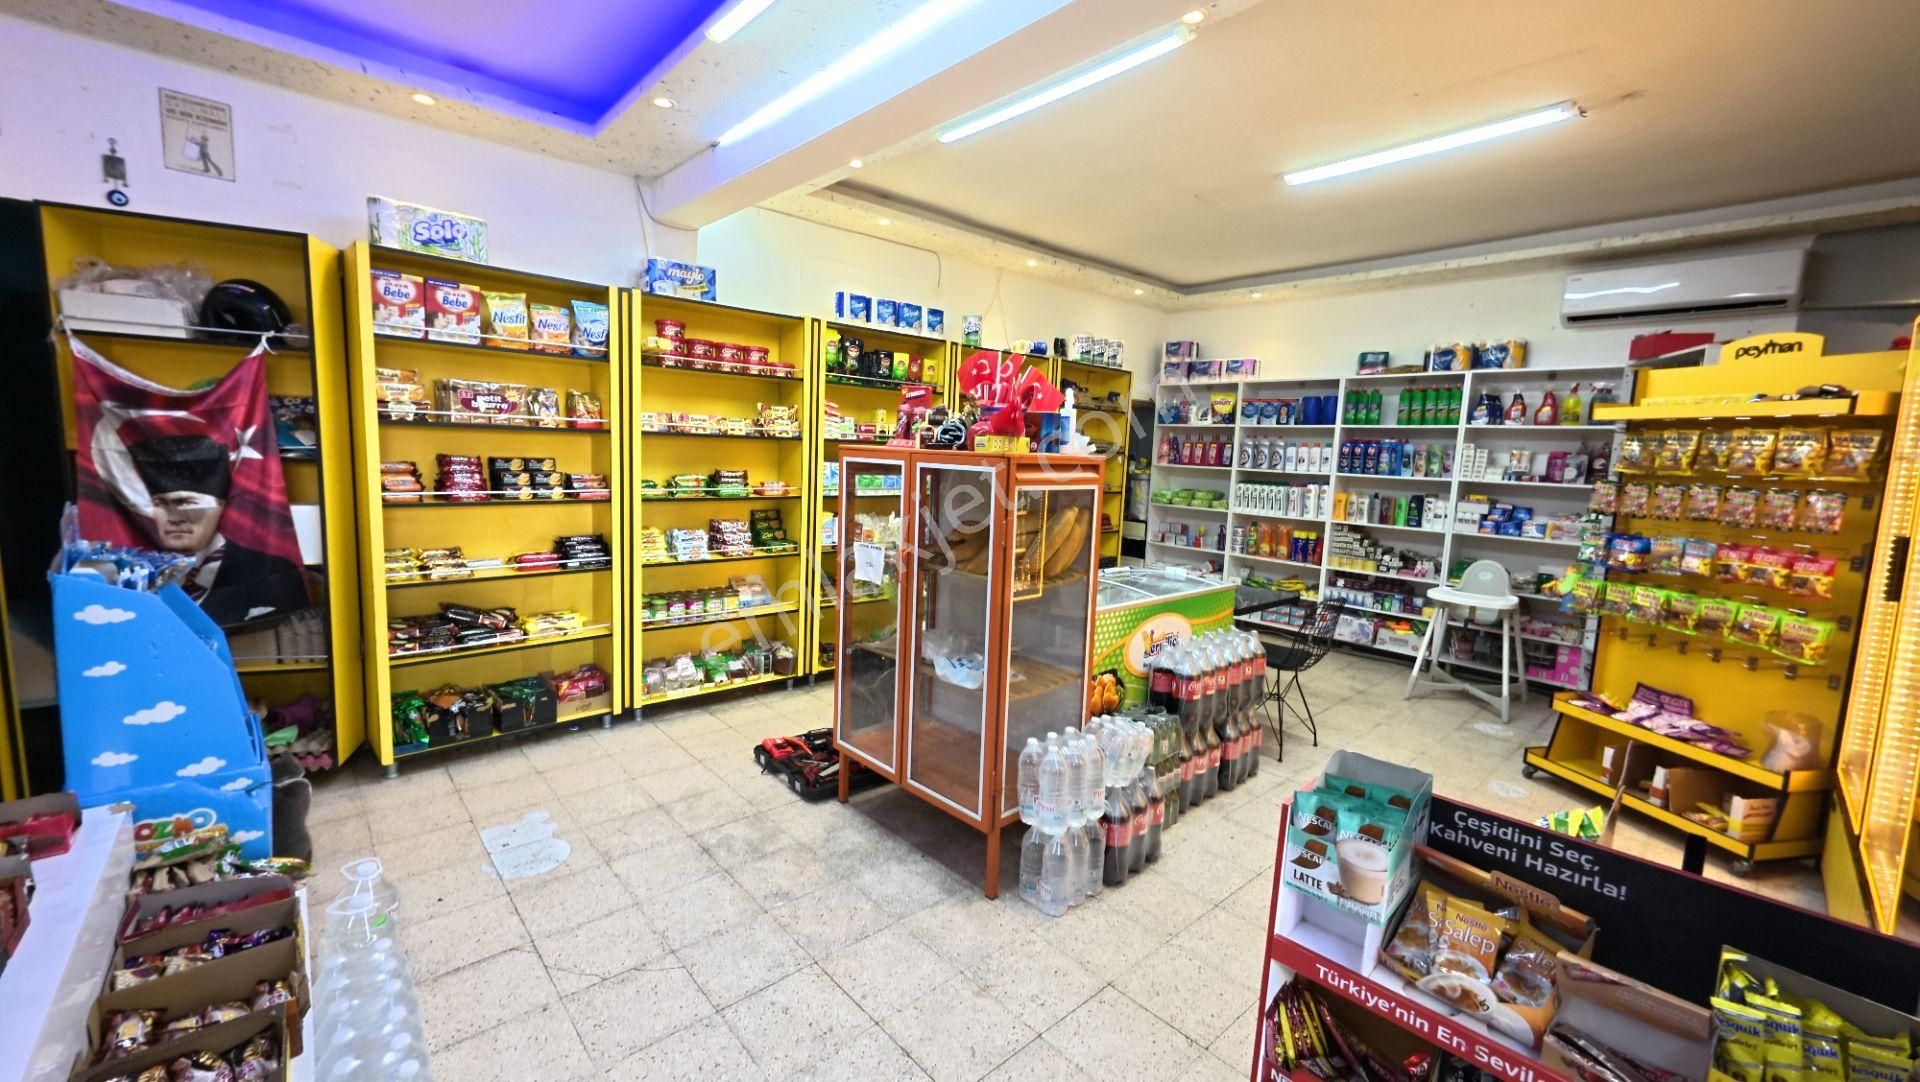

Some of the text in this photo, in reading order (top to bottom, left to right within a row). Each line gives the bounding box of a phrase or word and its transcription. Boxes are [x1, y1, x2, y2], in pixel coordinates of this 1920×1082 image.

[413, 219, 469, 245] Solo
[383, 286, 411, 300] Bebe
[442, 295, 468, 309] Bebe
[1735, 339, 1803, 360] peyman
[1453, 811, 1600, 872] Çeşidini Seç,
[1430, 820, 1517, 863] Kahveni
[1525, 854, 1627, 901] Hazırla!
[1293, 868, 1322, 891] LATTE
[1444, 918, 1496, 956] Salep
[1436, 1025, 1467, 1055] En
